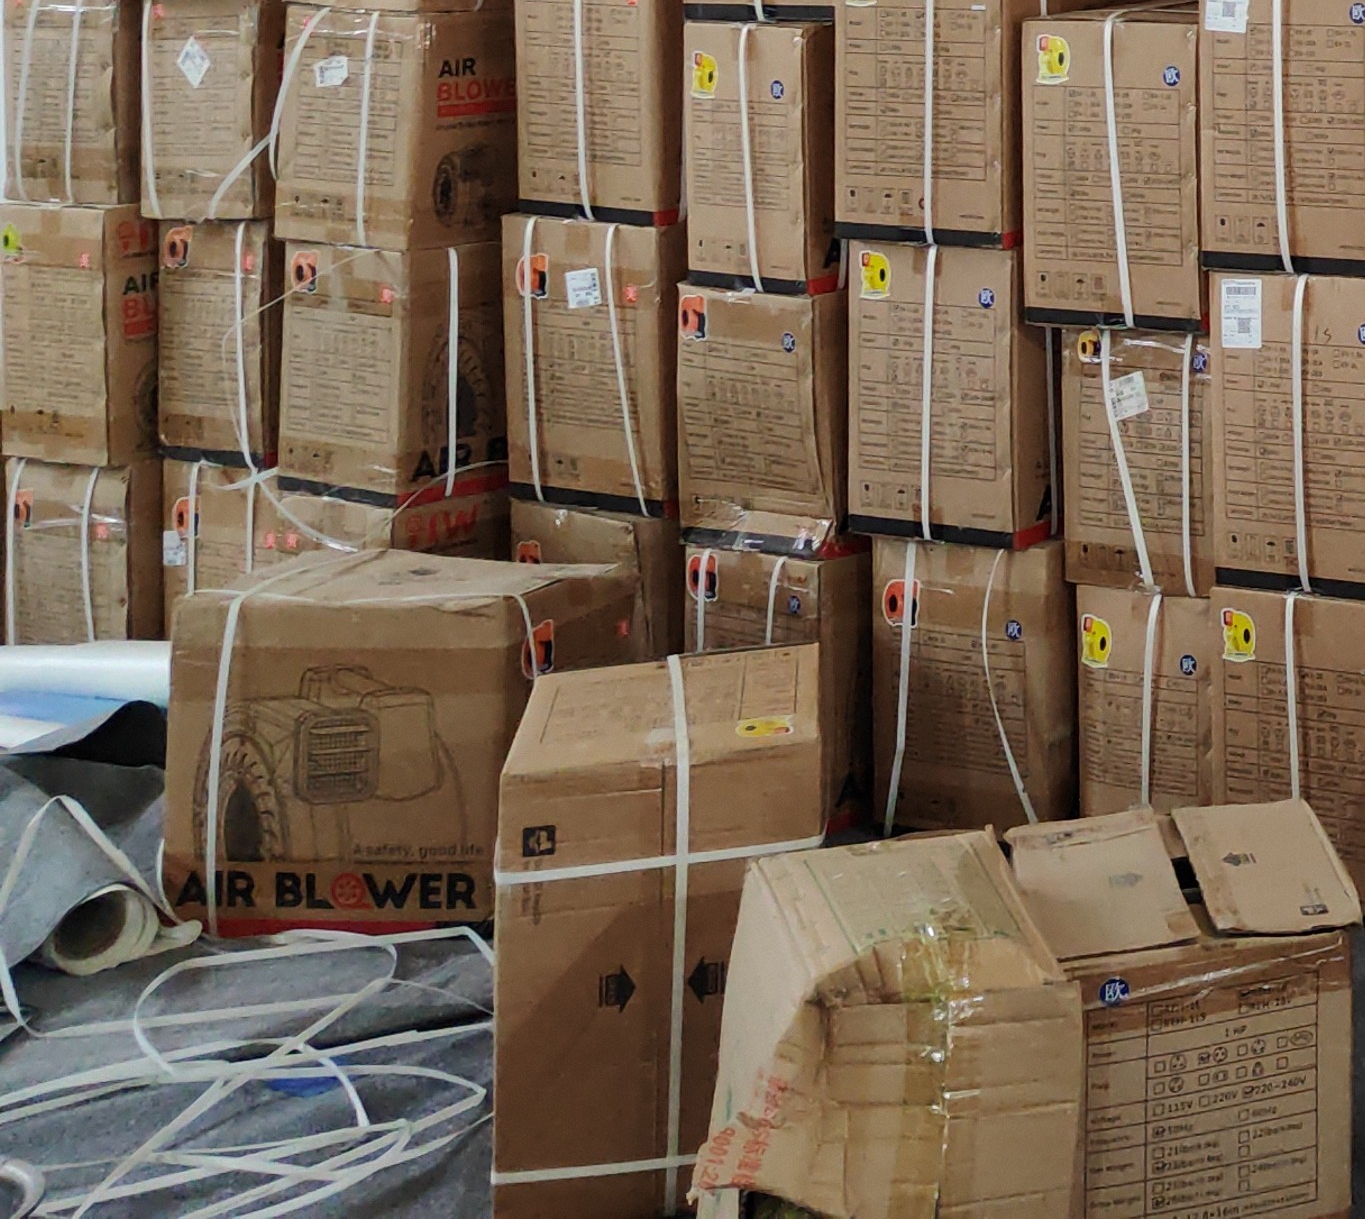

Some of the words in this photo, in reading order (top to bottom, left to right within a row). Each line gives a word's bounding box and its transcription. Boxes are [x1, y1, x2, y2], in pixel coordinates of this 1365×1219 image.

[1351, 6, 1365, 20] 欧
[438, 57, 477, 78] AIR
[1007, 623, 1022, 638] 欧
[1181, 656, 1195, 673] 欧
[275, 871, 477, 911] BLOWER
[1104, 982, 1128, 1000] 欧
